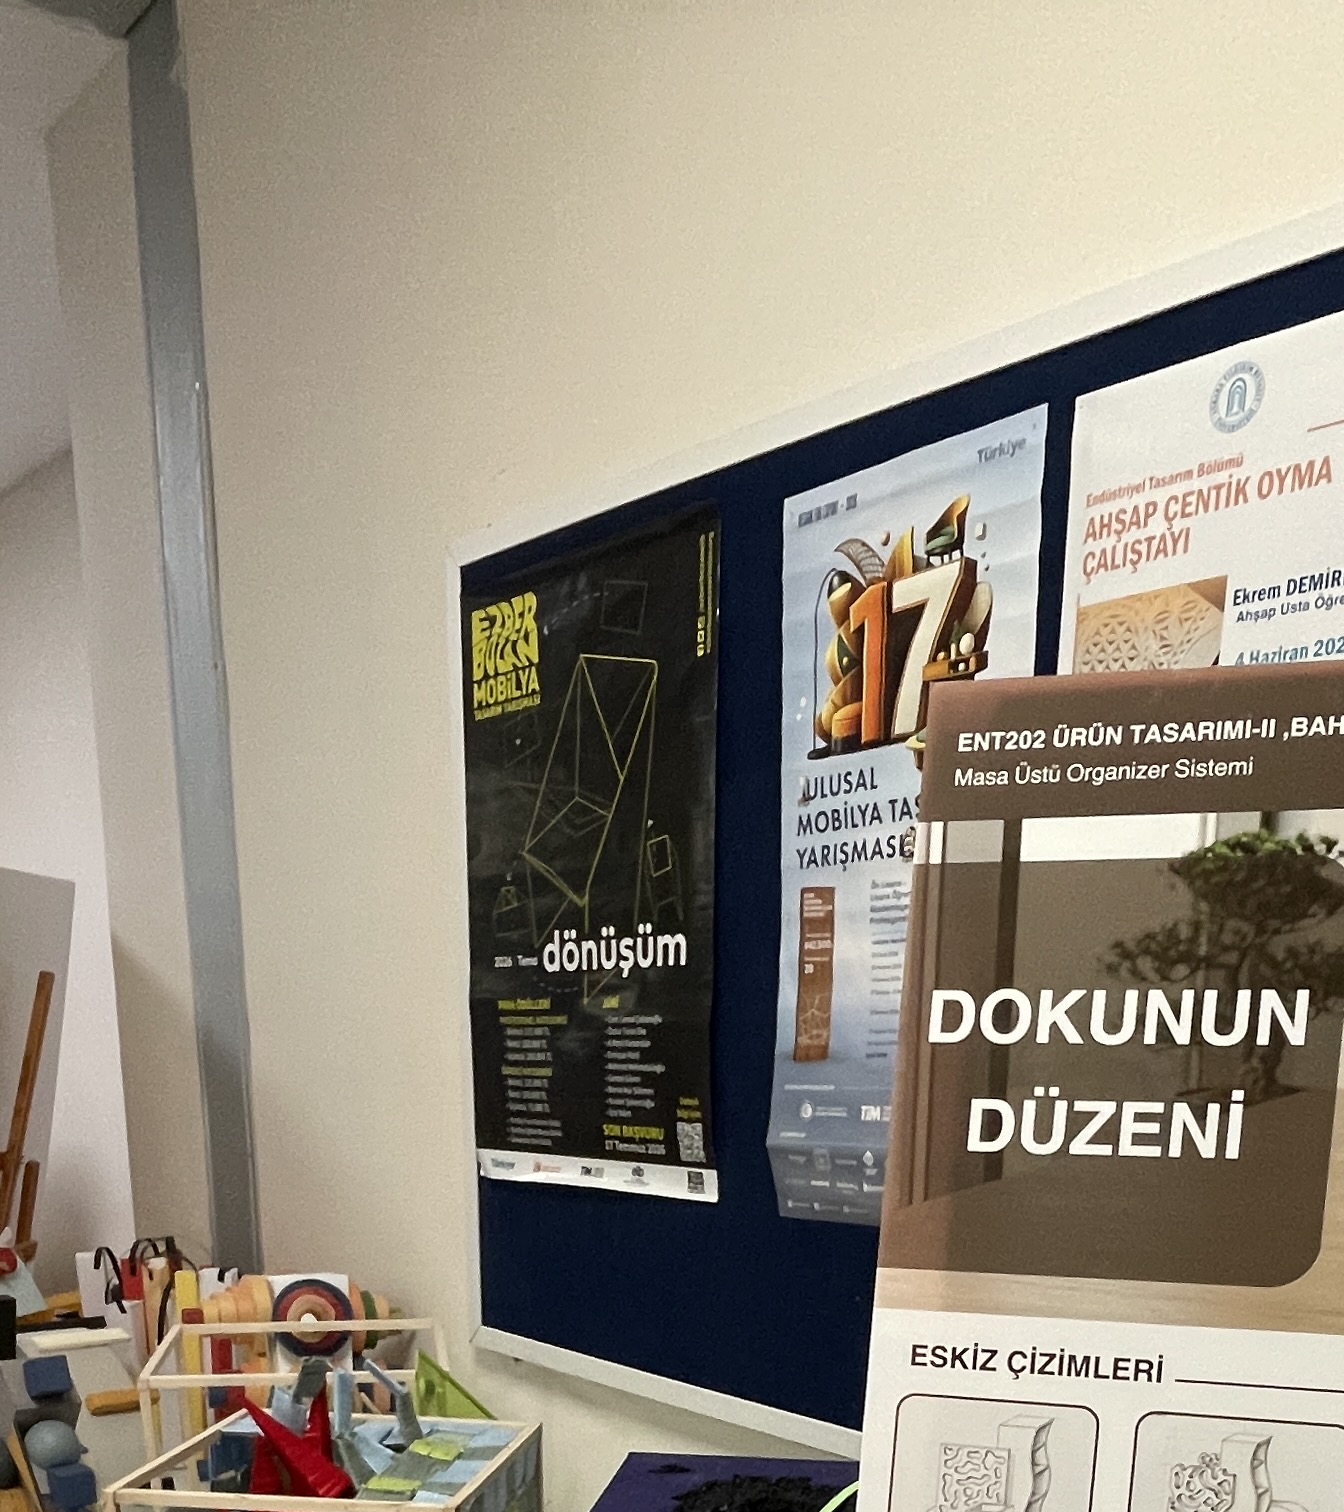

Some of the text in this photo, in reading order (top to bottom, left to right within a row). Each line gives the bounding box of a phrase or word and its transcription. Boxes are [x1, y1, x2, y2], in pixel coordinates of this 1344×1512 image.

[1083, 455, 1332, 544] AHŞAP ÇENTİK OYMA
[1086, 453, 1244, 508] Endüstriyel Tasarım Bölümü
[1082, 526, 1191, 585] ÇALIŞTAYI
[1233, 584, 1281, 606] Ekrem
[1236, 607, 1276, 623] Ahşap
[1280, 601, 1310, 615] Usta
[474, 666, 540, 708] MOBİLYA
[957, 729, 1046, 752] ENT202
[1052, 722, 1123, 748] ÜRÜN
[1130, 718, 1277, 744] TASARIMI-II
[803, 767, 879, 802] ULUSAL
[954, 756, 1254, 786] Masa Üstü Organizer Sistemi
[797, 801, 883, 836] MOBİLYA
[796, 834, 907, 871] YARIŞMASI
[543, 922, 687, 978] dönüşüm
[927, 987, 1310, 1047] DOKUNUN
[966, 1086, 1245, 1160] DÜZENİ
[910, 1342, 1165, 1383] ESKİZ ÇİZİMLERİ
